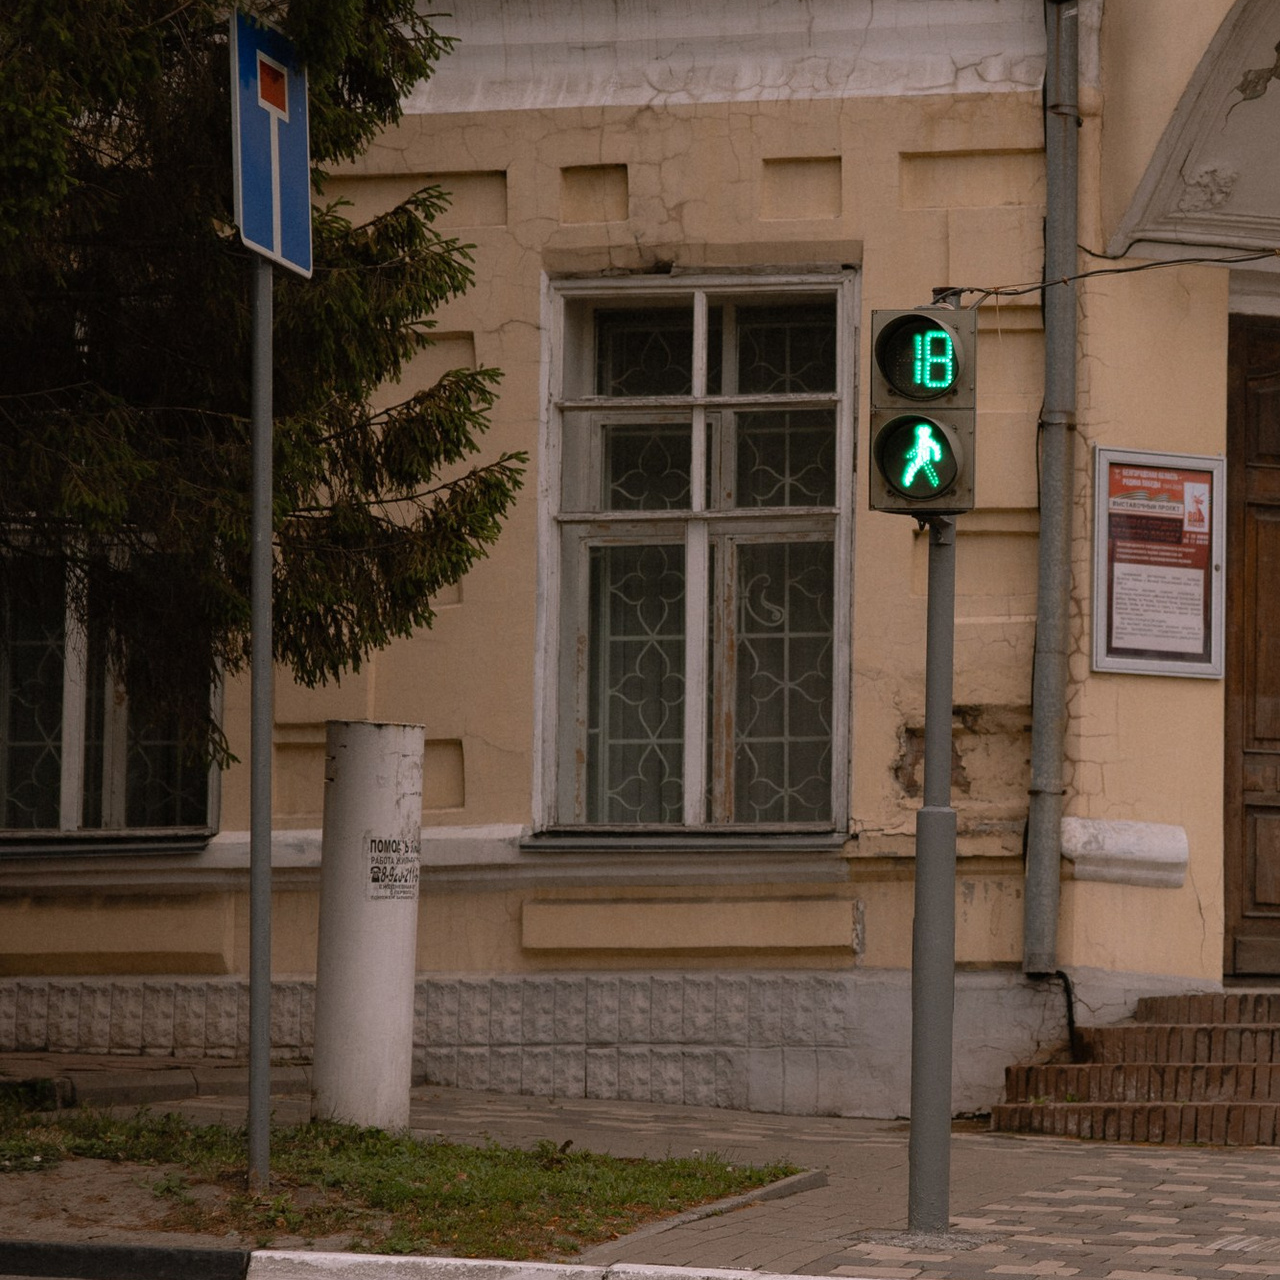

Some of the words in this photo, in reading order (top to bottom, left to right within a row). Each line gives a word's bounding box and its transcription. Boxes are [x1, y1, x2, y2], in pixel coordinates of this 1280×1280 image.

[913, 330, 953, 388] 18
[1158, 504, 1180, 513] ПРОЕКТ
[371, 856, 394, 865] РАБОТА
